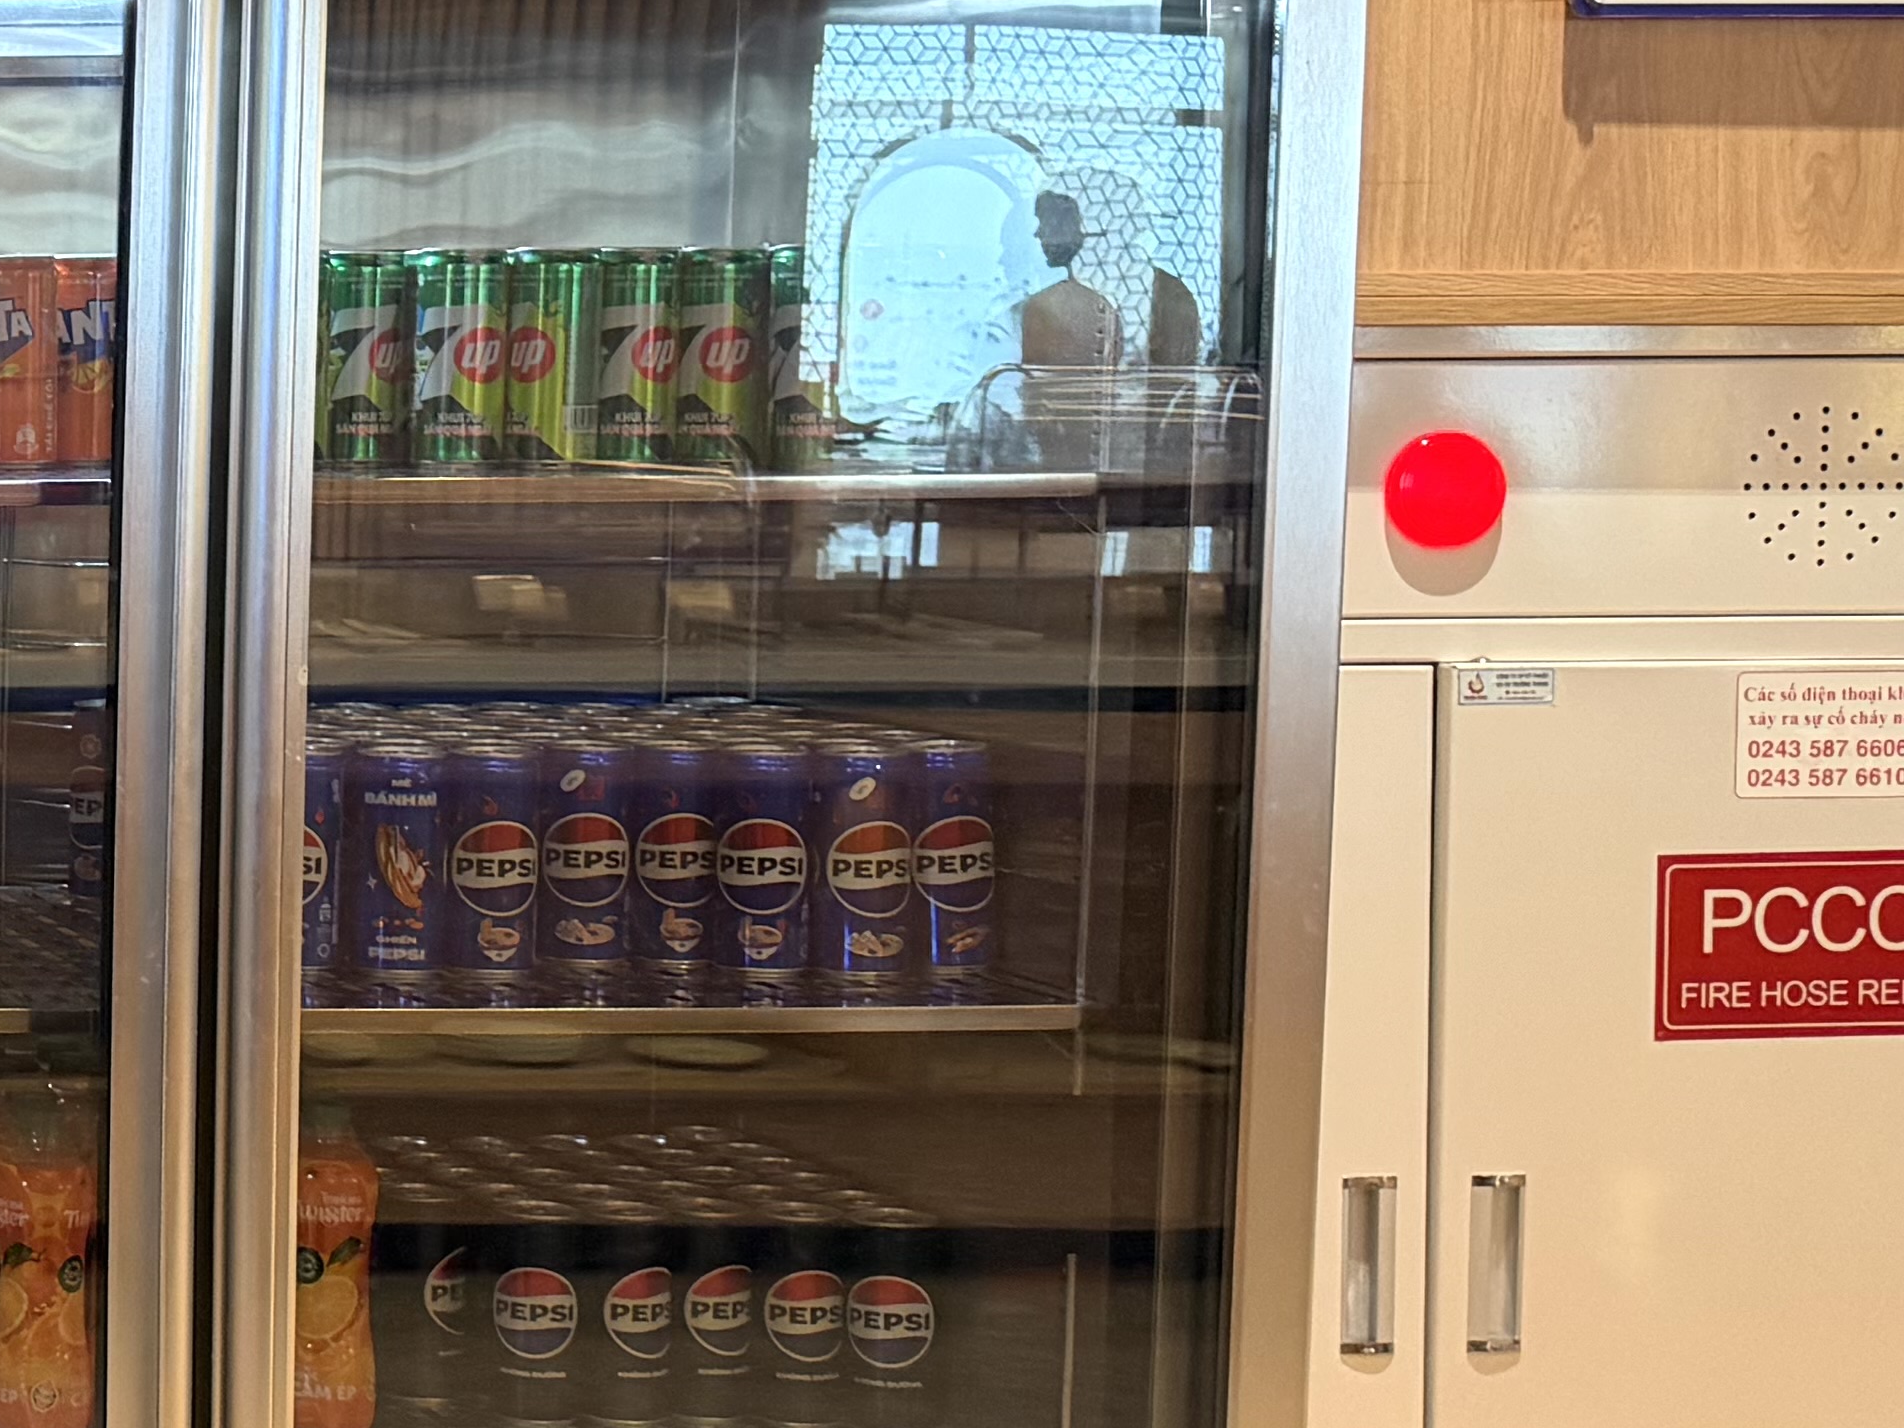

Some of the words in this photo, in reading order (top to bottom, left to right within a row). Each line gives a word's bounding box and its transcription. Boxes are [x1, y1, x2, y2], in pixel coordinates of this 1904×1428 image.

[1743, 686, 1775, 702] Các
[1841, 686, 1882, 705] thoại
[1782, 714, 1799, 725] ra
[1748, 740, 1801, 758] 0243
[1809, 740, 1849, 758] 587
[1747, 768, 1800, 787] 0243
[1808, 768, 1848, 787] 587
[545, 848, 626, 871] PEPSI
[640, 850, 716, 871] PEPS
[720, 856, 803, 876] PEPSI
[832, 858, 910, 879] PEPS
[915, 851, 993, 874] PEPS
[1681, 982, 1751, 1009] FIRE
[1760, 980, 1849, 1008] HOSE
[1858, 978, 1904, 1005] RE
[496, 1300, 574, 1322] PEPSI
[768, 1304, 843, 1324] PEPS
[849, 1309, 930, 1331] PEPSI
